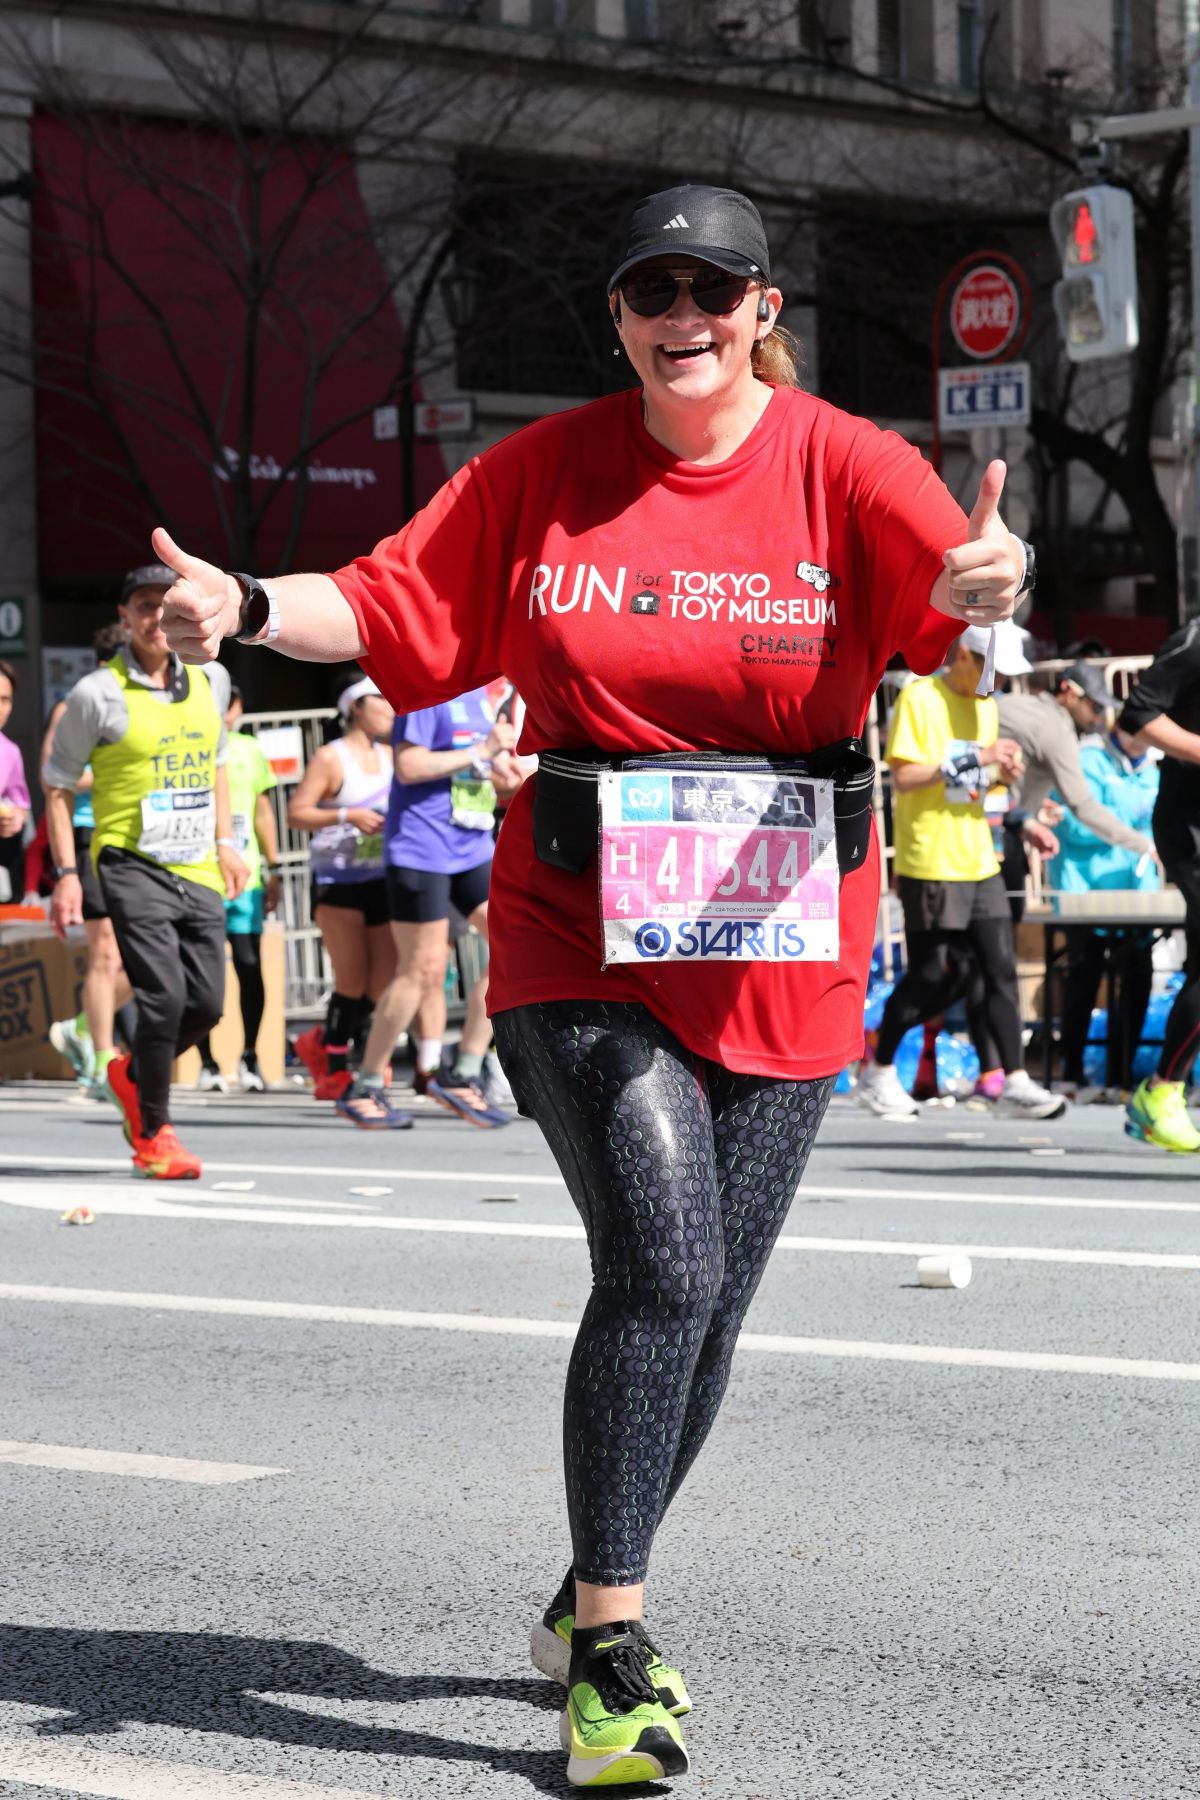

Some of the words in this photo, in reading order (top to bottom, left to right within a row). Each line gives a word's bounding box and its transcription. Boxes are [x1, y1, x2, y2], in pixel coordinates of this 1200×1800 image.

[952, 384, 1018, 414] KEN
[528, 563, 627, 620] RUN
[635, 569, 664, 587] for
[670, 570, 771, 598] TOKYO
[667, 594, 727, 621] TOY
[728, 598, 837, 626] MUSEUM
[740, 633, 837, 657] CHARITY
[741, 655, 769, 665] TOKYO
[771, 657, 819, 668] MARATHON
[151, 750, 212, 773] TEAM
[164, 770, 210, 790] KIDS
[610, 842, 637, 875] H
[655, 835, 801, 898] 41544
[615, 892, 632, 915] 4
